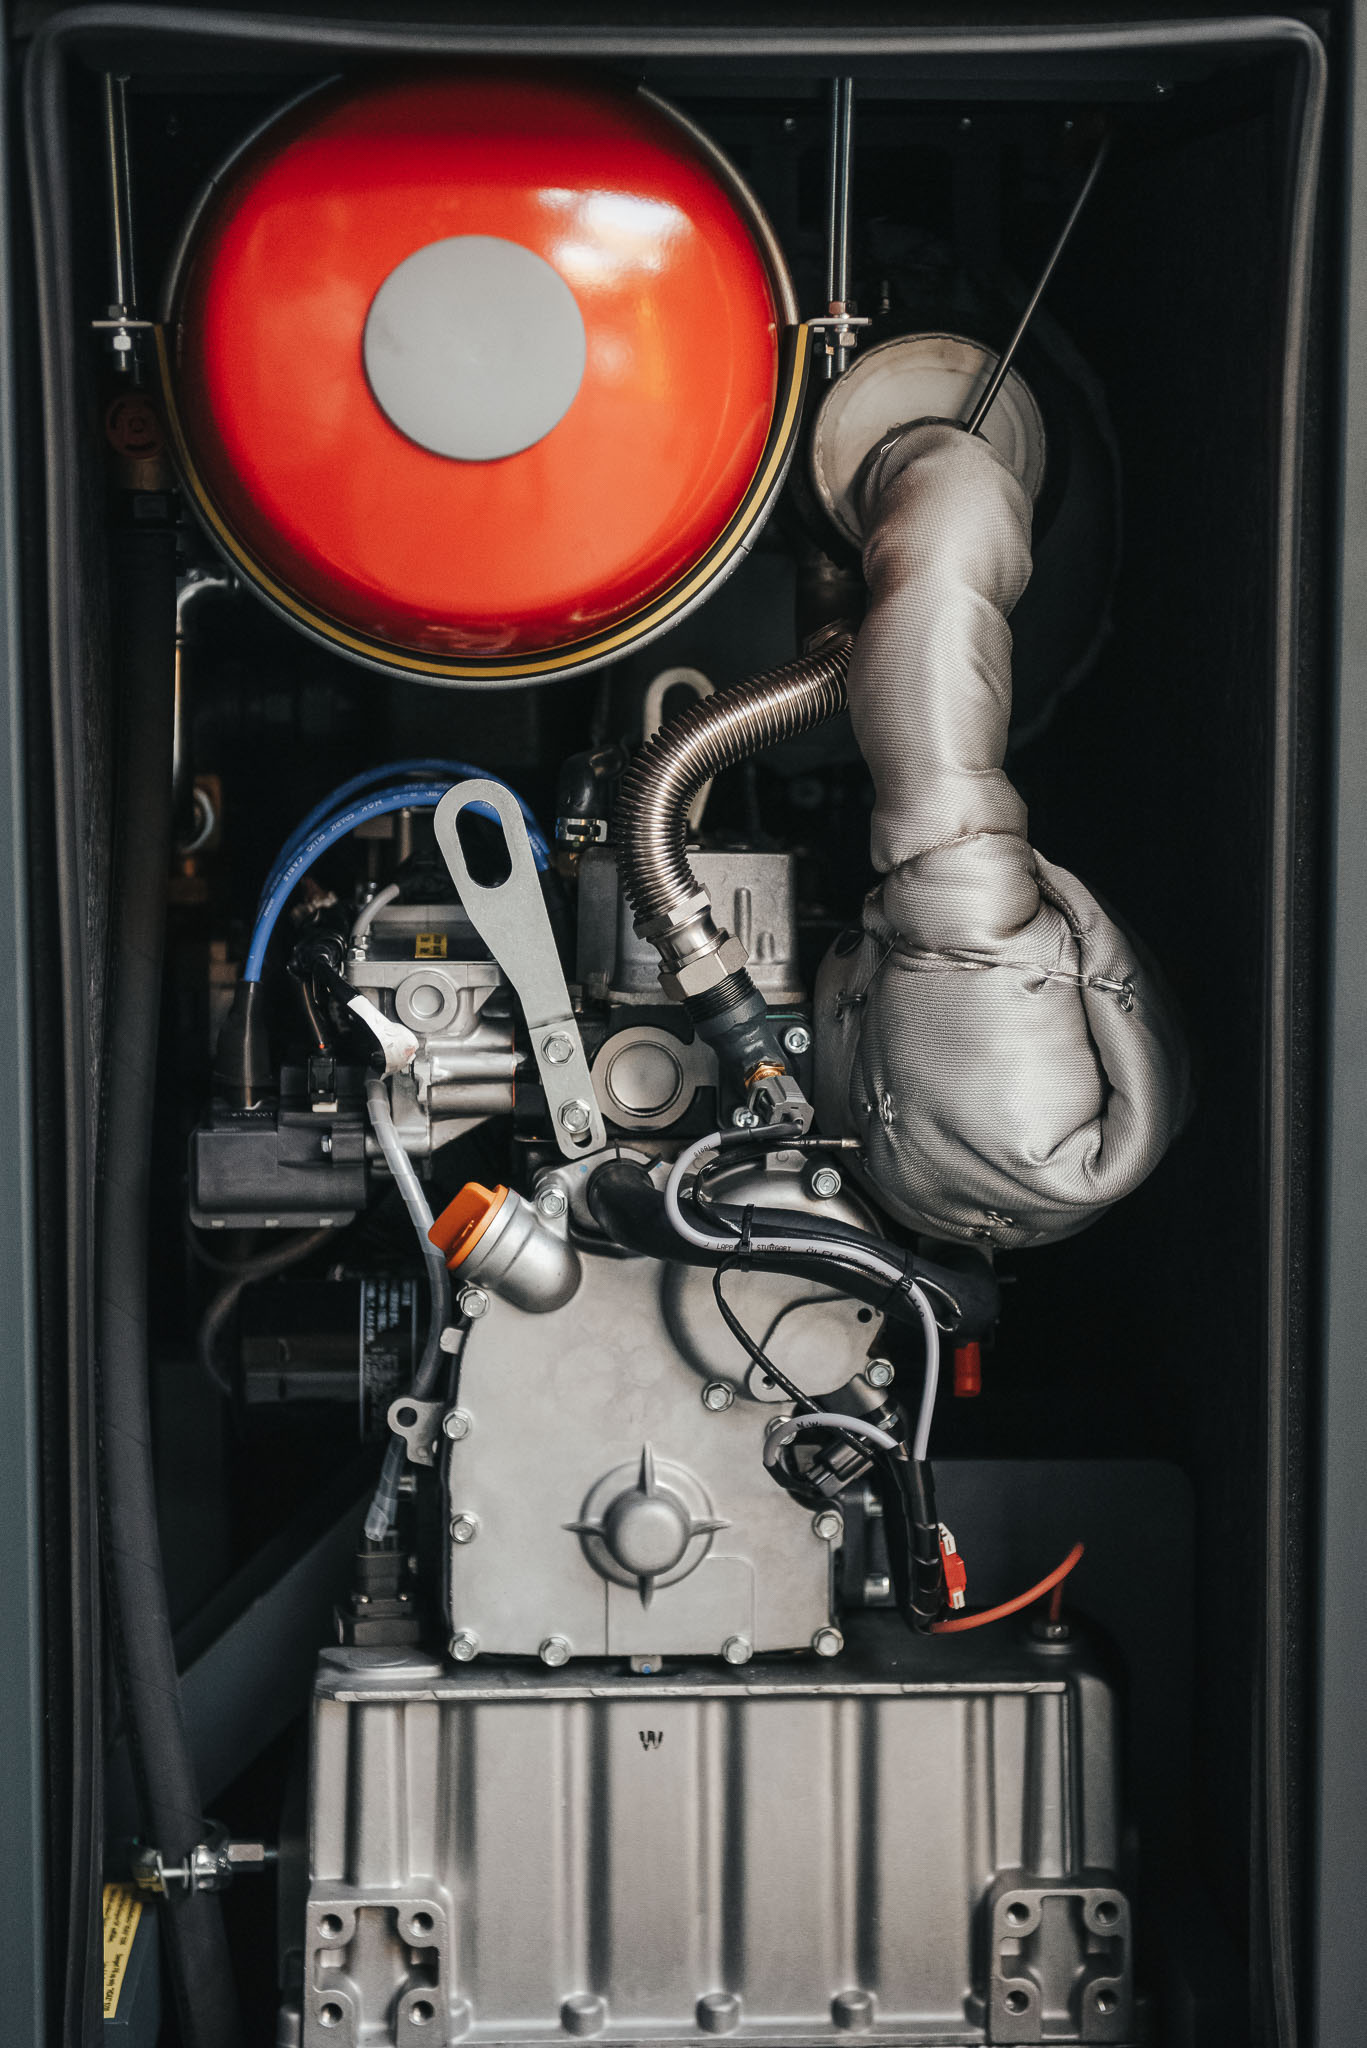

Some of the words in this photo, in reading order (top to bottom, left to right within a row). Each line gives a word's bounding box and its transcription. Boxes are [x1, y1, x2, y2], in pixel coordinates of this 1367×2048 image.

[361, 799, 383, 812] NGK
[330, 813, 355, 831] SPARK
[306, 833, 326, 852] PLUG
[284, 856, 303, 881] CABLE
